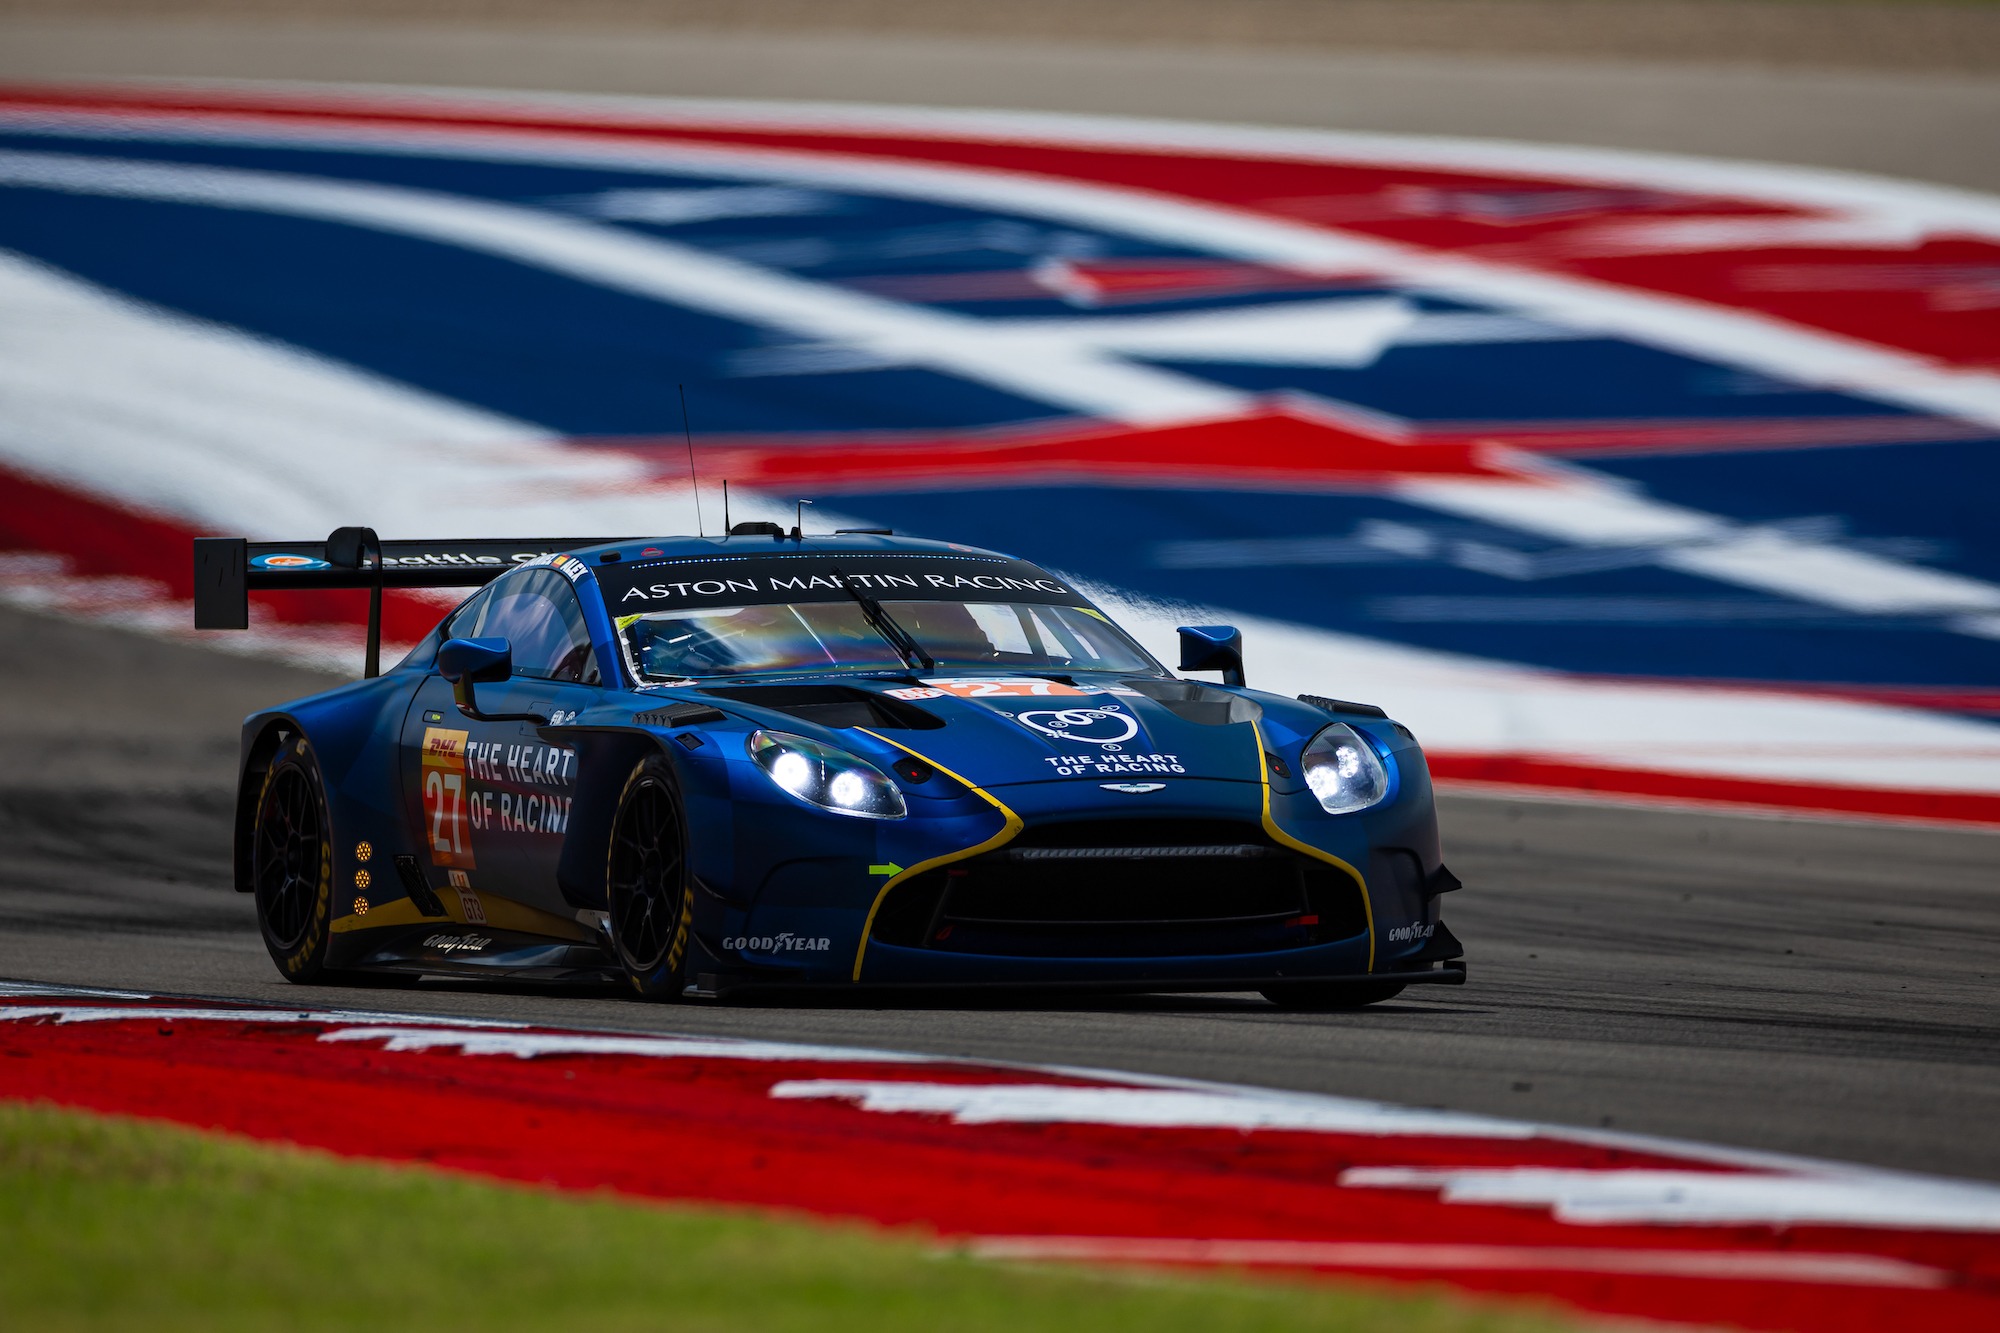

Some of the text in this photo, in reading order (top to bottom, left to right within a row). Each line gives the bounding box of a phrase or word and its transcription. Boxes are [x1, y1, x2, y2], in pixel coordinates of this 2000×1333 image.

[362, 553, 501, 566] eattle
[560, 557, 589, 583] ALEX
[621, 578, 759, 602] ASTON
[924, 574, 1068, 595] RACING
[950, 682, 1052, 697] 27
[429, 737, 458, 758] DHL
[467, 741, 575, 786] THE HEART
[1044, 753, 1178, 767] THE HEART
[1056, 763, 1186, 776] OF RACING
[426, 770, 463, 854] 27
[470, 791, 494, 831] OF
[463, 897, 484, 921] GT3
[722, 933, 831, 954] GOODYEAR
